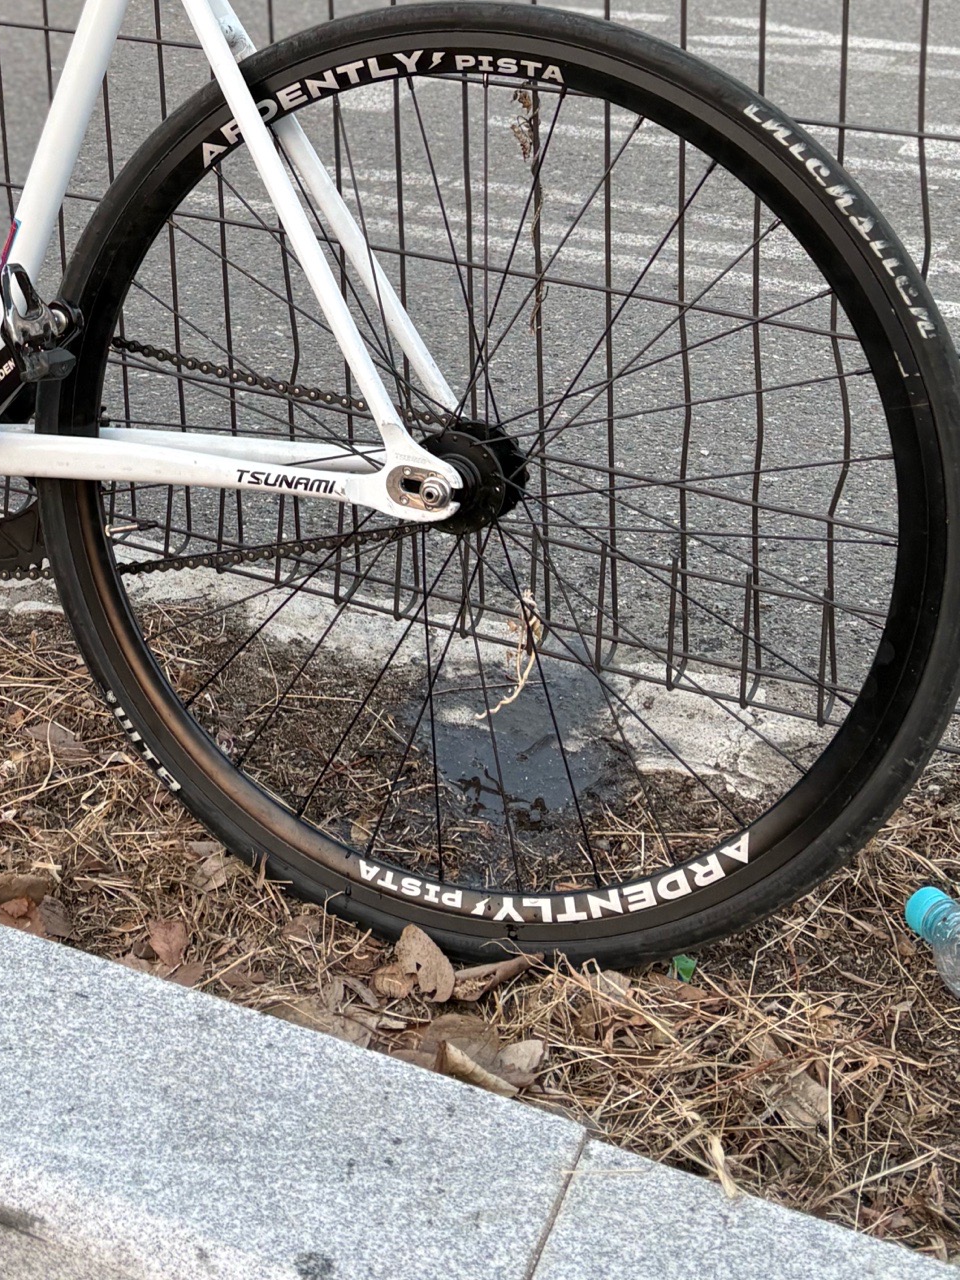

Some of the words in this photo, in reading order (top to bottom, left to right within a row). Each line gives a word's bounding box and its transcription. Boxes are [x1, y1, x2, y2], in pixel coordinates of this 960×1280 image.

[454, 54, 565, 84] PISTA
[236, 469, 337, 495] TSUNAMI
[357, 858, 464, 908] PISTA
[492, 831, 751, 923] ARDENTLY
